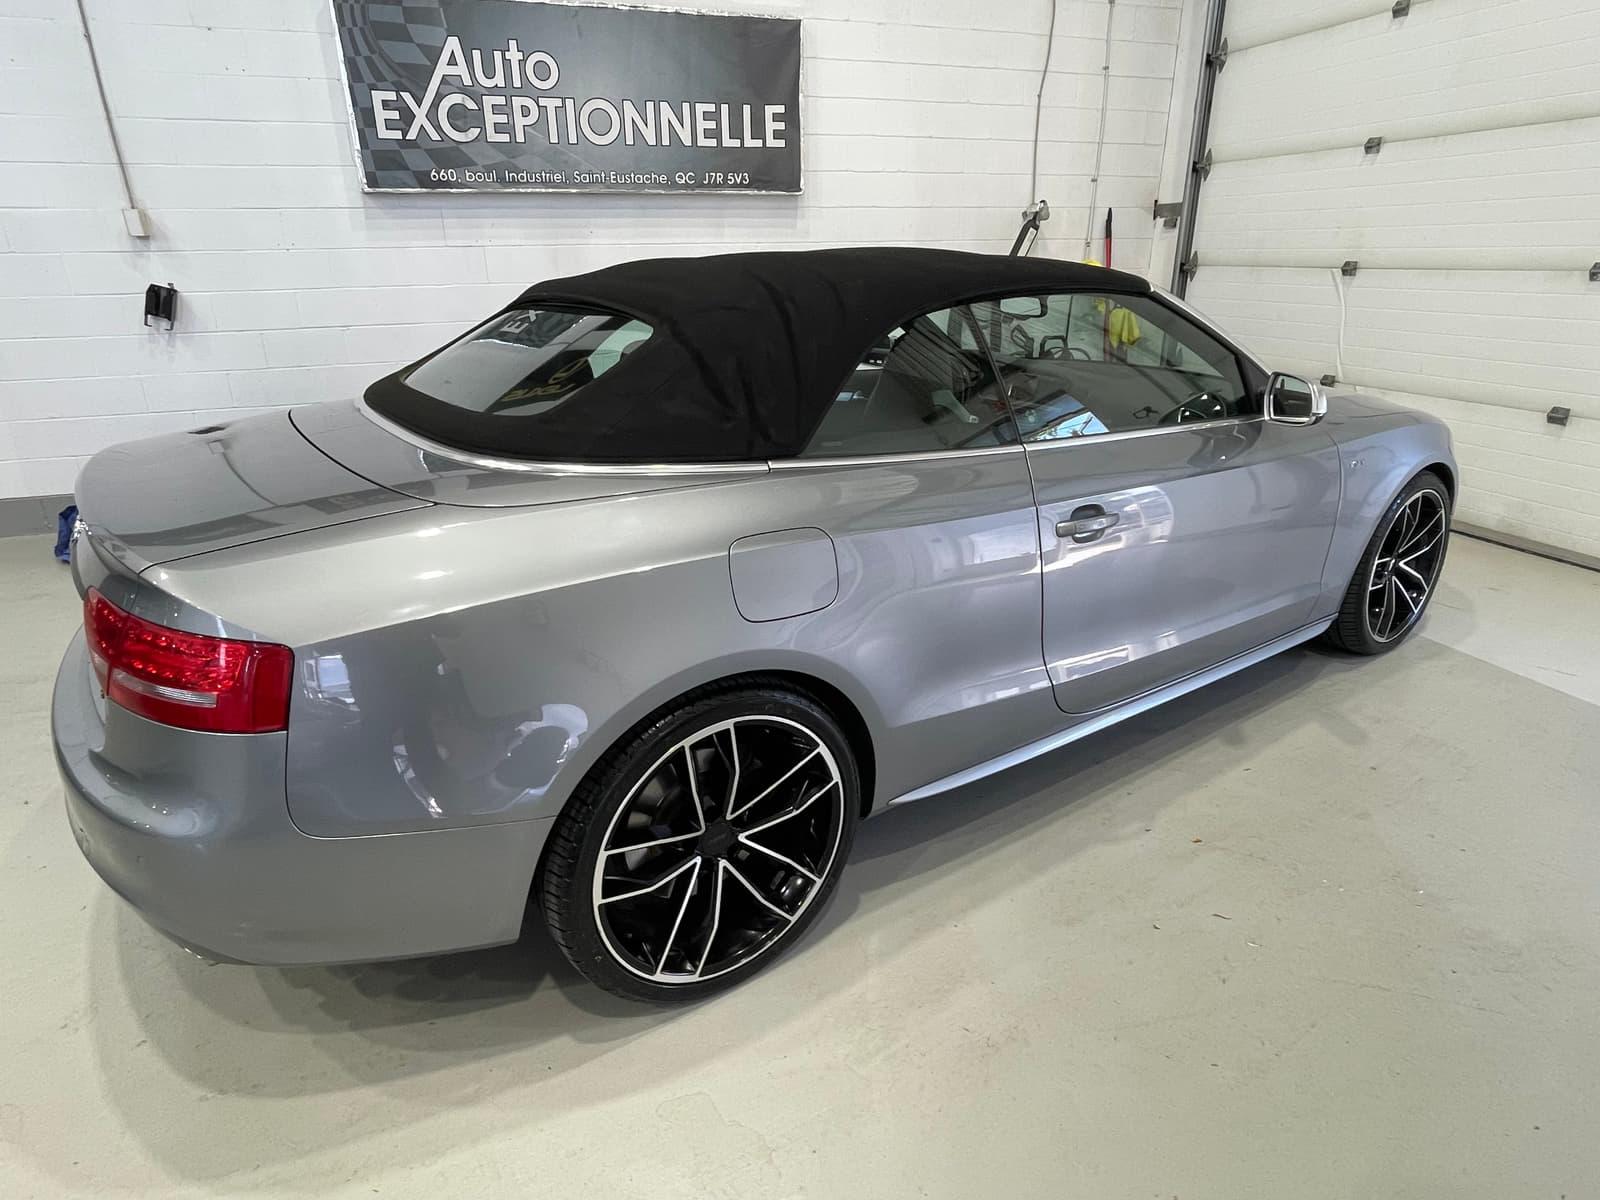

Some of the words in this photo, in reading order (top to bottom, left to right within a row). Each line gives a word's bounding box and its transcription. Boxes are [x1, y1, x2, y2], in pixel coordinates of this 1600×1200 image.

[428, 35, 560, 90] Auto
[370, 89, 787, 148] EXCEPTIONNELLE
[430, 168, 462, 183] 660,
[465, 169, 501, 183] boul.
[505, 170, 570, 184] Industriel,
[573, 170, 672, 185] Saint-Eustache,
[675, 172, 696, 185] QC
[703, 172, 724, 185] J7R
[727, 172, 750, 185] 5V3
